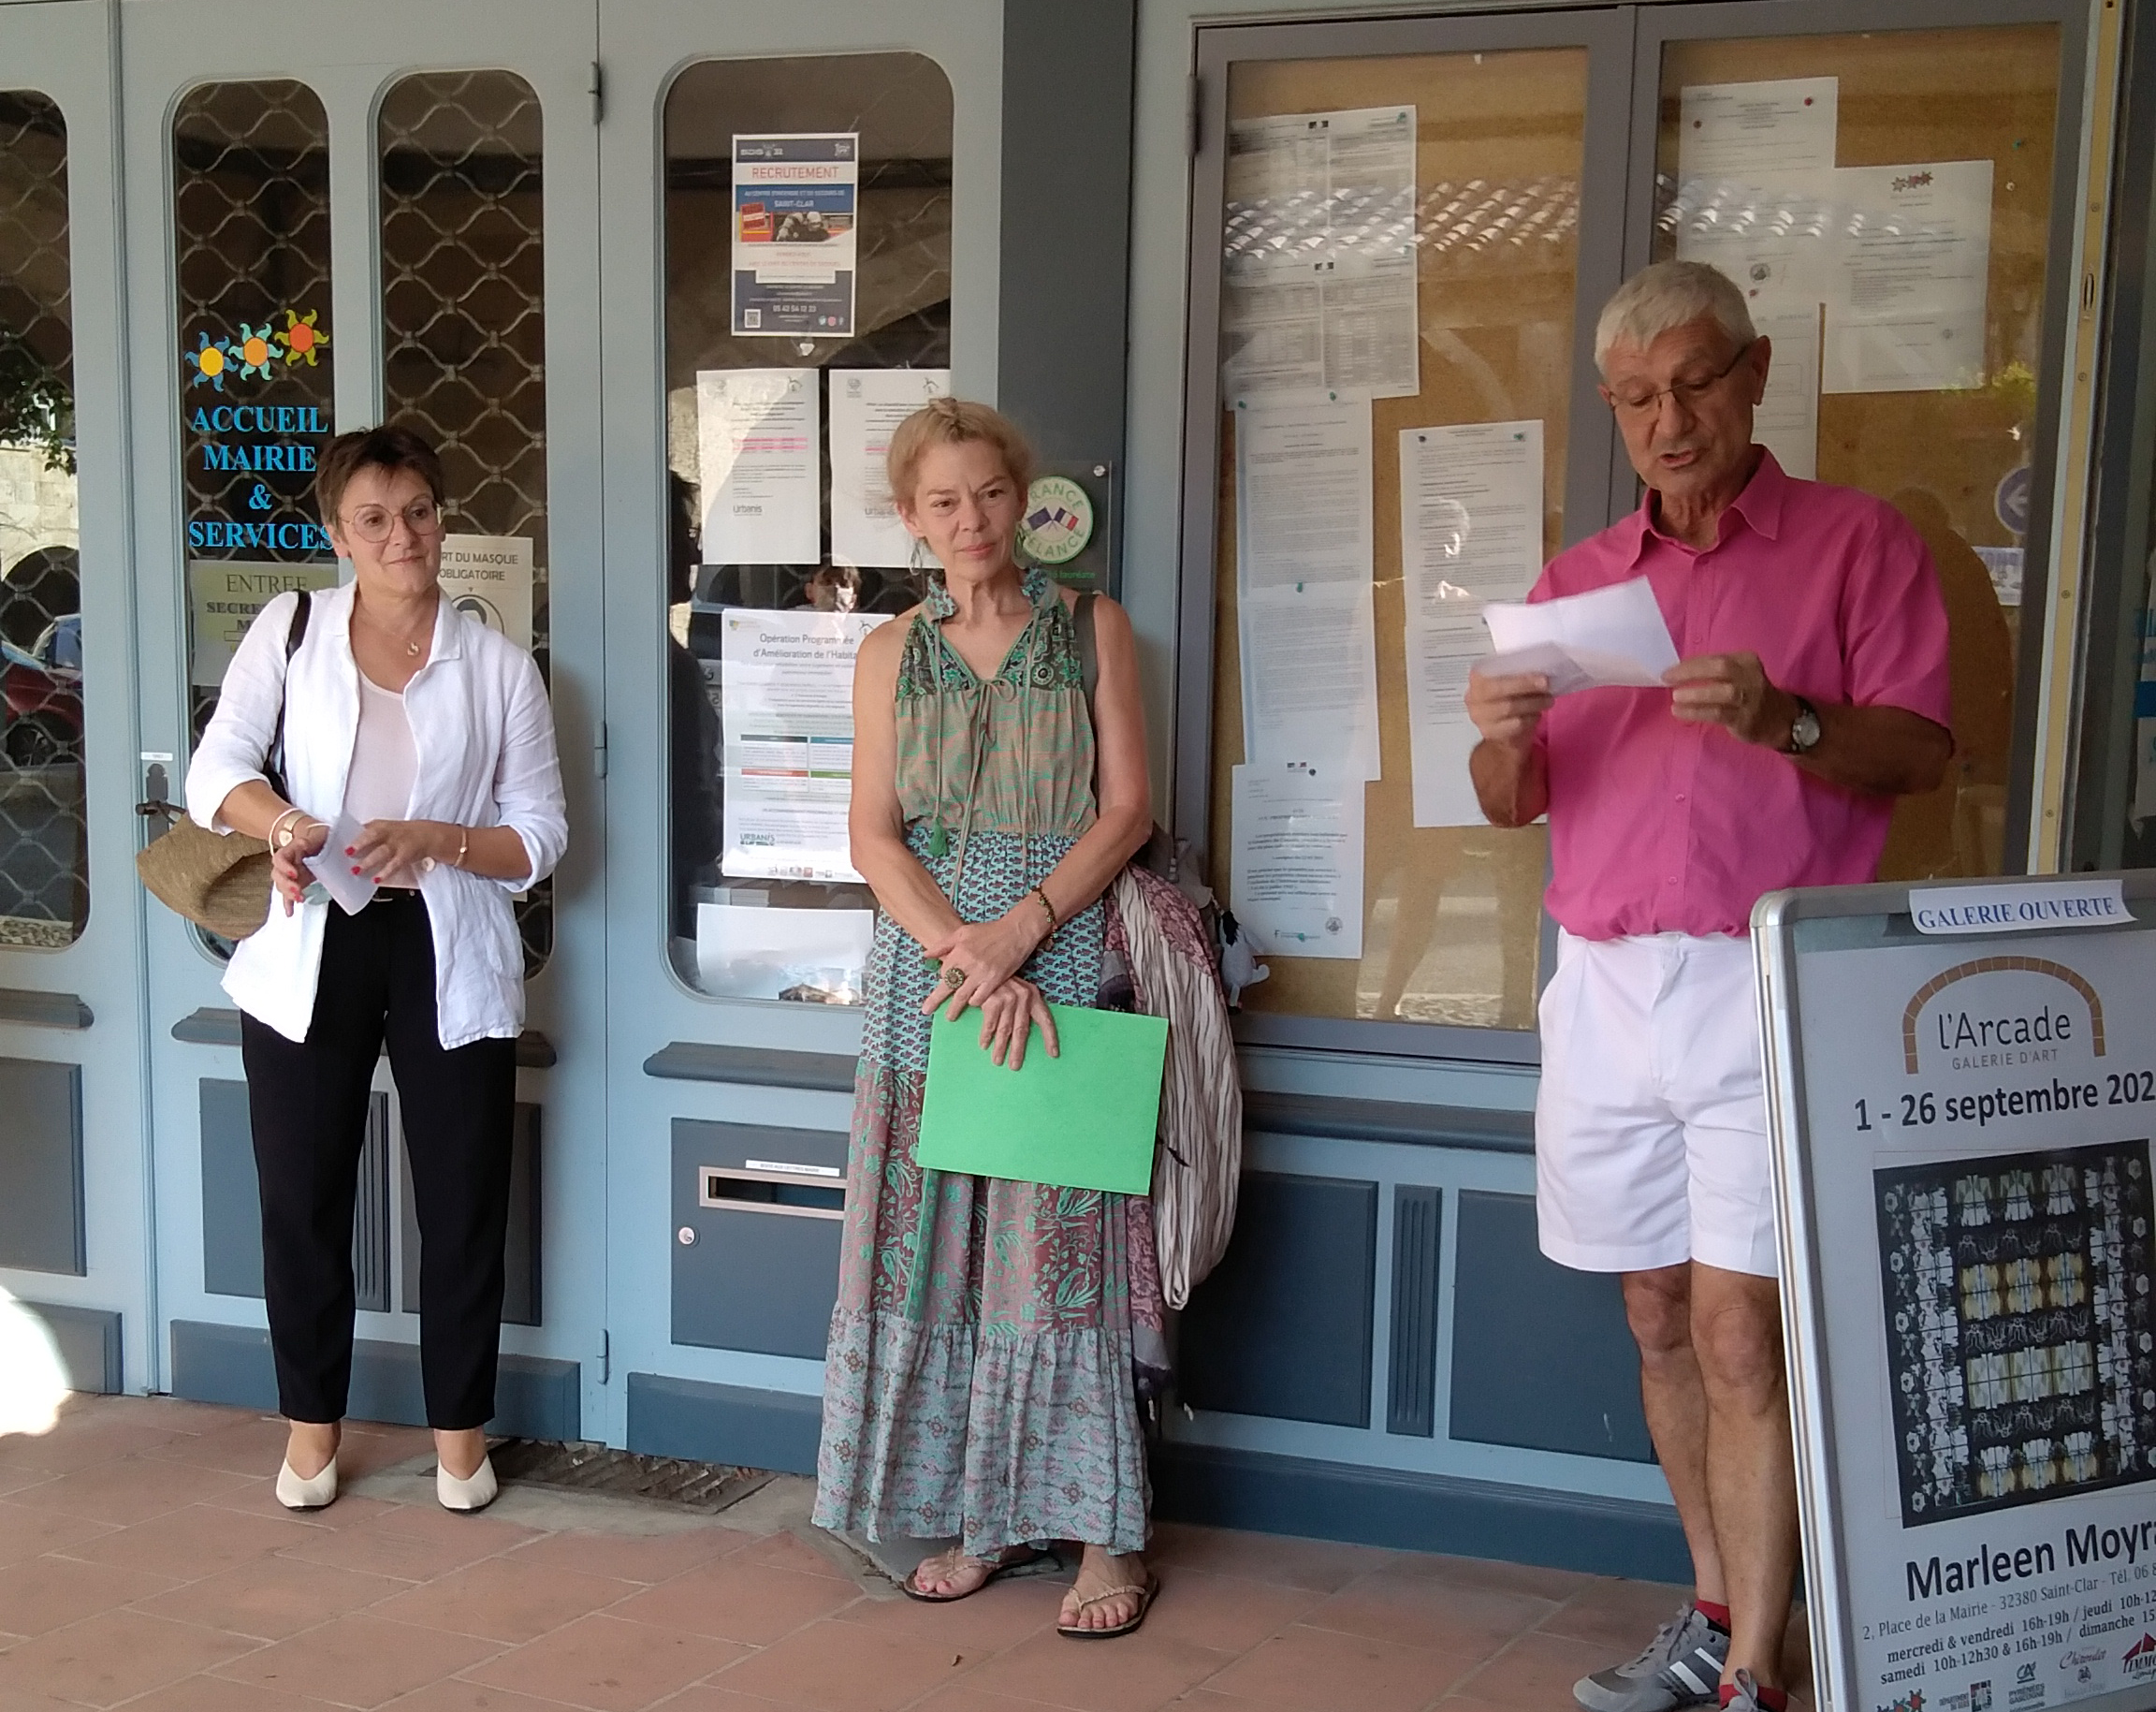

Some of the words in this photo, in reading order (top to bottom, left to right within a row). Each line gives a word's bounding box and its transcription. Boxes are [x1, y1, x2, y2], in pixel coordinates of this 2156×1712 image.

[751, 167, 839, 179] RECRUTEMENT
[191, 405, 328, 433] ACCUEIL
[202, 445, 317, 472] MAIRIE
[248, 484, 272, 510] &
[1029, 483, 1084, 510] RANCE
[189, 521, 334, 550] SERVICES
[456, 552, 470, 563] DU
[473, 553, 518, 565] MASQUE
[439, 568, 505, 580] OBLIGATOIRE
[760, 633, 801, 644] Opération
[814, 650, 824, 659] de
[826, 650, 857, 660] l'Habita
[1918, 903, 2016, 929] GALERIE
[2019, 897, 2118, 921] OUVERTE
[1938, 1005, 2071, 1050] l'Arcade
[1952, 1053, 2014, 1070] GALERIE
[2019, 1048, 2058, 1064] D'ART
[1854, 1098, 1872, 1132] 1
[1900, 1091, 1937, 1127] 26
[1945, 1077, 2099, 1127] septembre
[2106, 1071, 2156, 1105] 202
[1905, 1543, 2055, 1602] Marleen
[2065, 1520, 2156, 1567] Moyr
[1879, 1619, 1912, 1637] Place
[1916, 1613, 1931, 1629] de
[1935, 1609, 1946, 1625] la
[1950, 1601, 1988, 1621] Mairie
[1999, 1589, 2037, 1610] 32380
[2041, 1577, 2099, 1602] Saint-Clar
[2134, 1564, 2149, 1580] 06
[1886, 1637, 1945, 1663] mercredi
[1947, 1635, 1957, 1649] &
[1960, 1620, 2015, 1646] vendredi
[2022, 1609, 2070, 1632] 16h-19h
[2082, 1599, 2113, 1621] jeudi
[2120, 1589, 2156, 1610] 10h-12
[1880, 1661, 1926, 1685] samedi
[1933, 1645, 1999, 1673] 10h-12h30
[2002, 1642, 2011, 1657] &
[2016, 1630, 2063, 1653] 16h-19h
[2079, 1614, 2135, 1638] dimanche
[2142, 1609, 2155, 1623] 15
